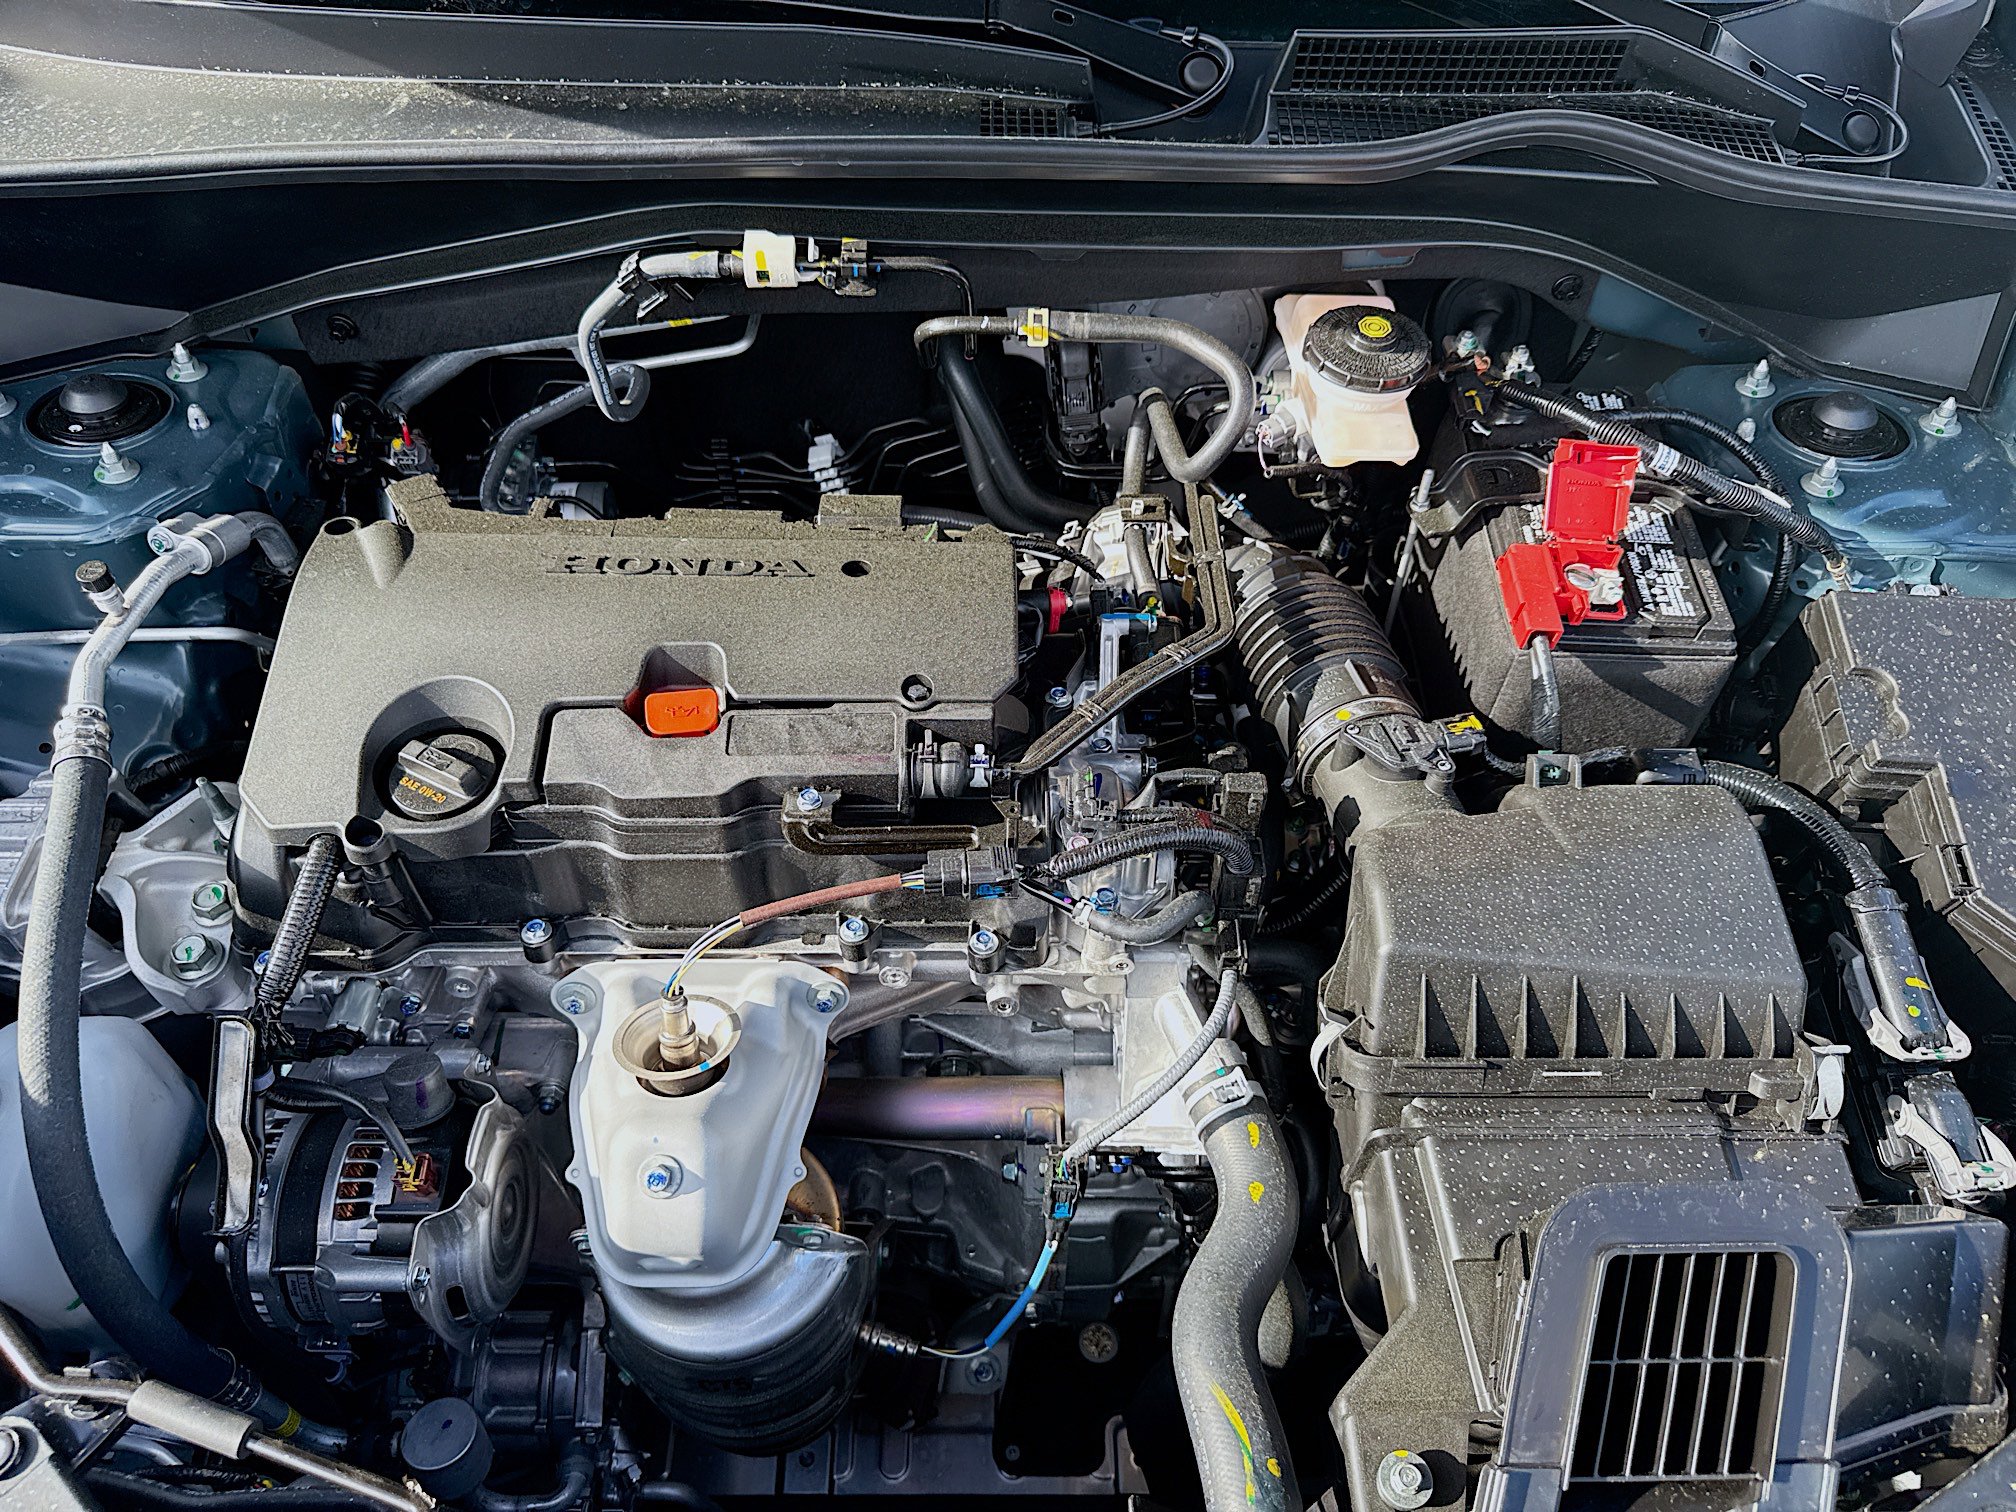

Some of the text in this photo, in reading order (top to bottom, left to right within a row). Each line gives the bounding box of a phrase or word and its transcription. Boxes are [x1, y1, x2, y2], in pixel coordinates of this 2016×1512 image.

[545, 554, 816, 578] HONDA
[398, 776, 421, 791] SAE
[418, 785, 448, 804] 0W-20
